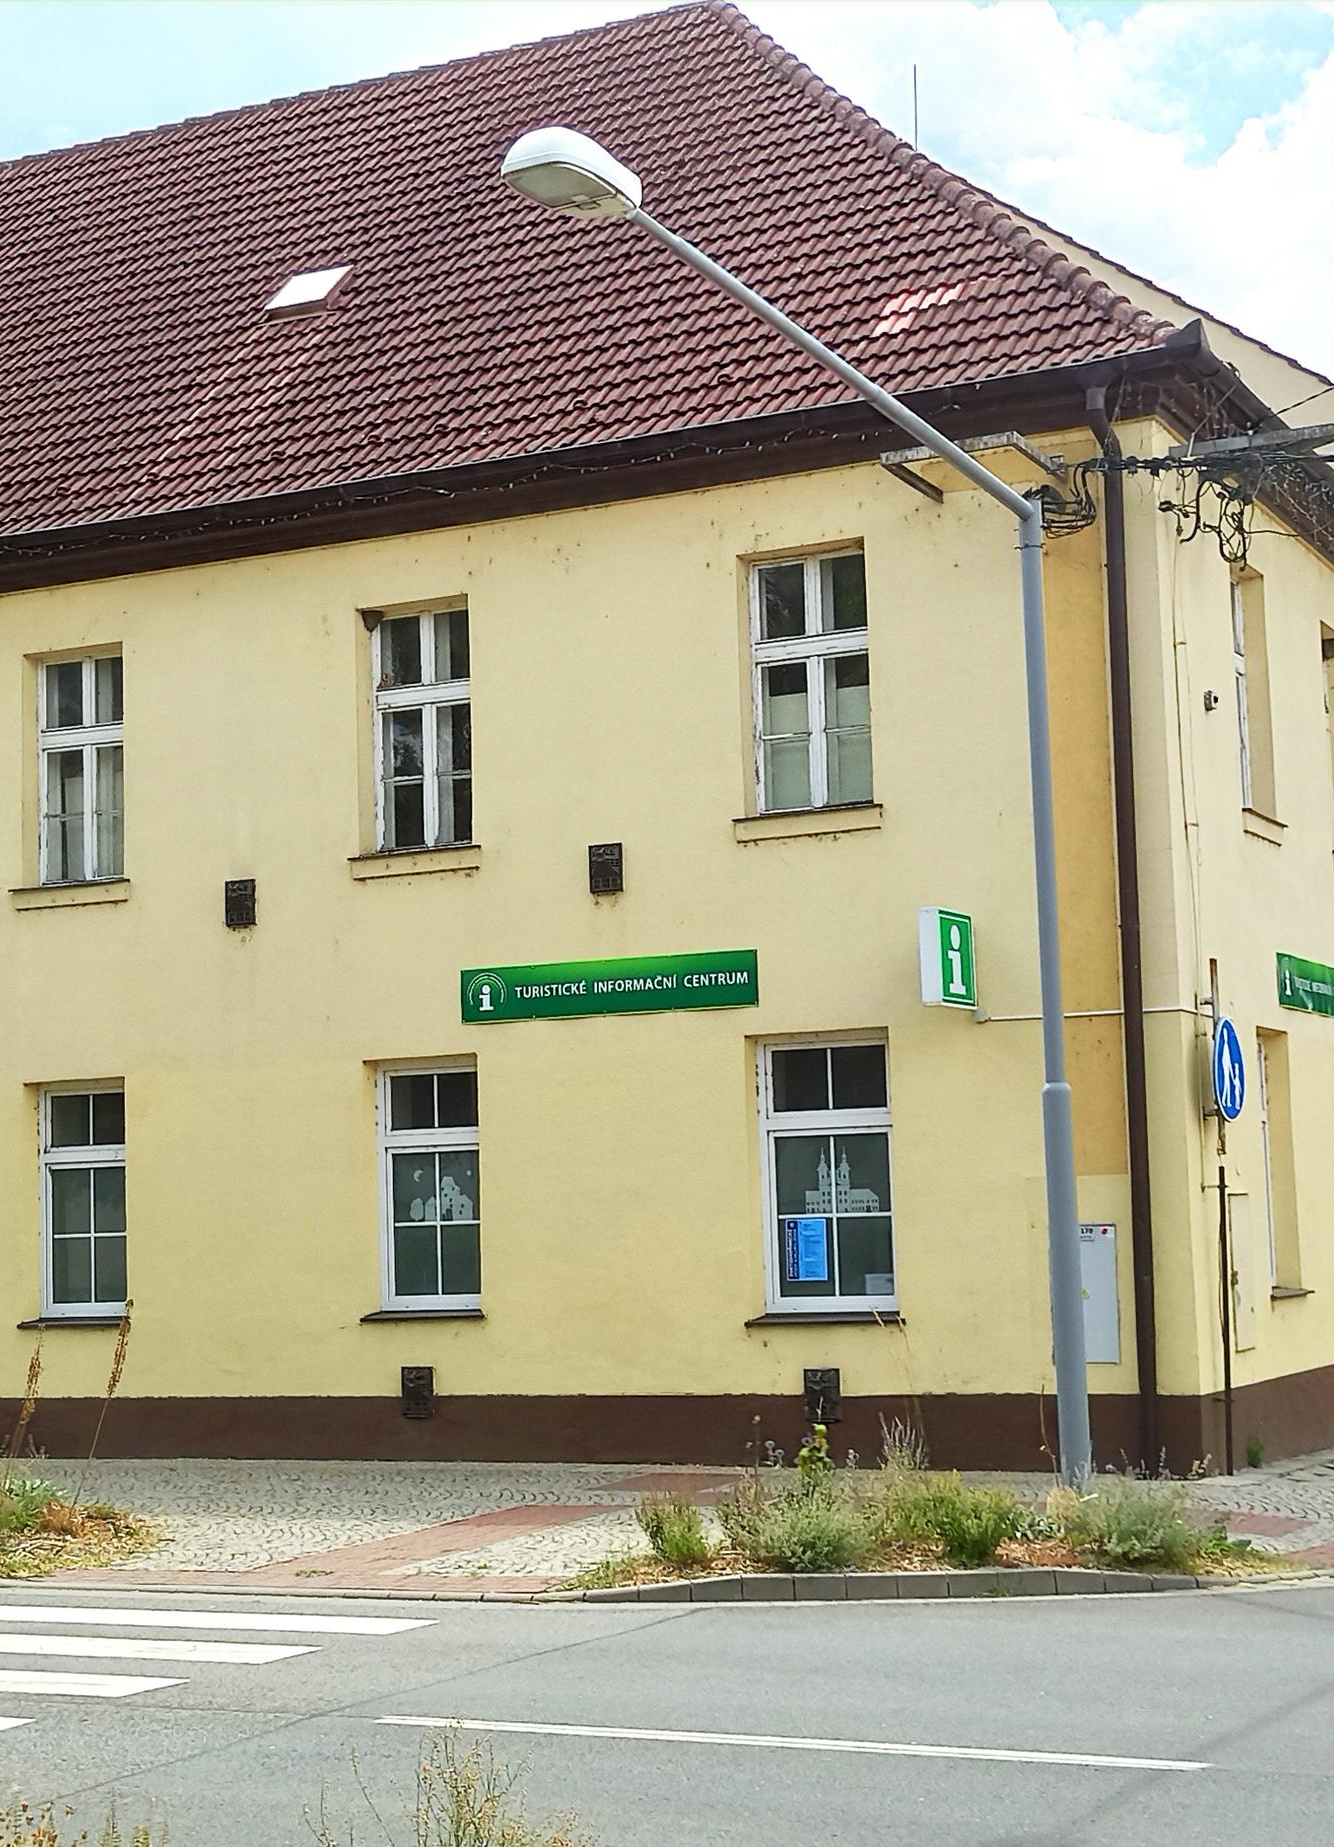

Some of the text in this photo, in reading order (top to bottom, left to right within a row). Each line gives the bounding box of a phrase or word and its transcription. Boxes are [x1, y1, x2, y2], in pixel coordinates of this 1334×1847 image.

[514, 979, 588, 999] TURISTICKÉ
[593, 973, 678, 995] INFORMAČNÍ
[683, 970, 750, 988] CENTRUM
